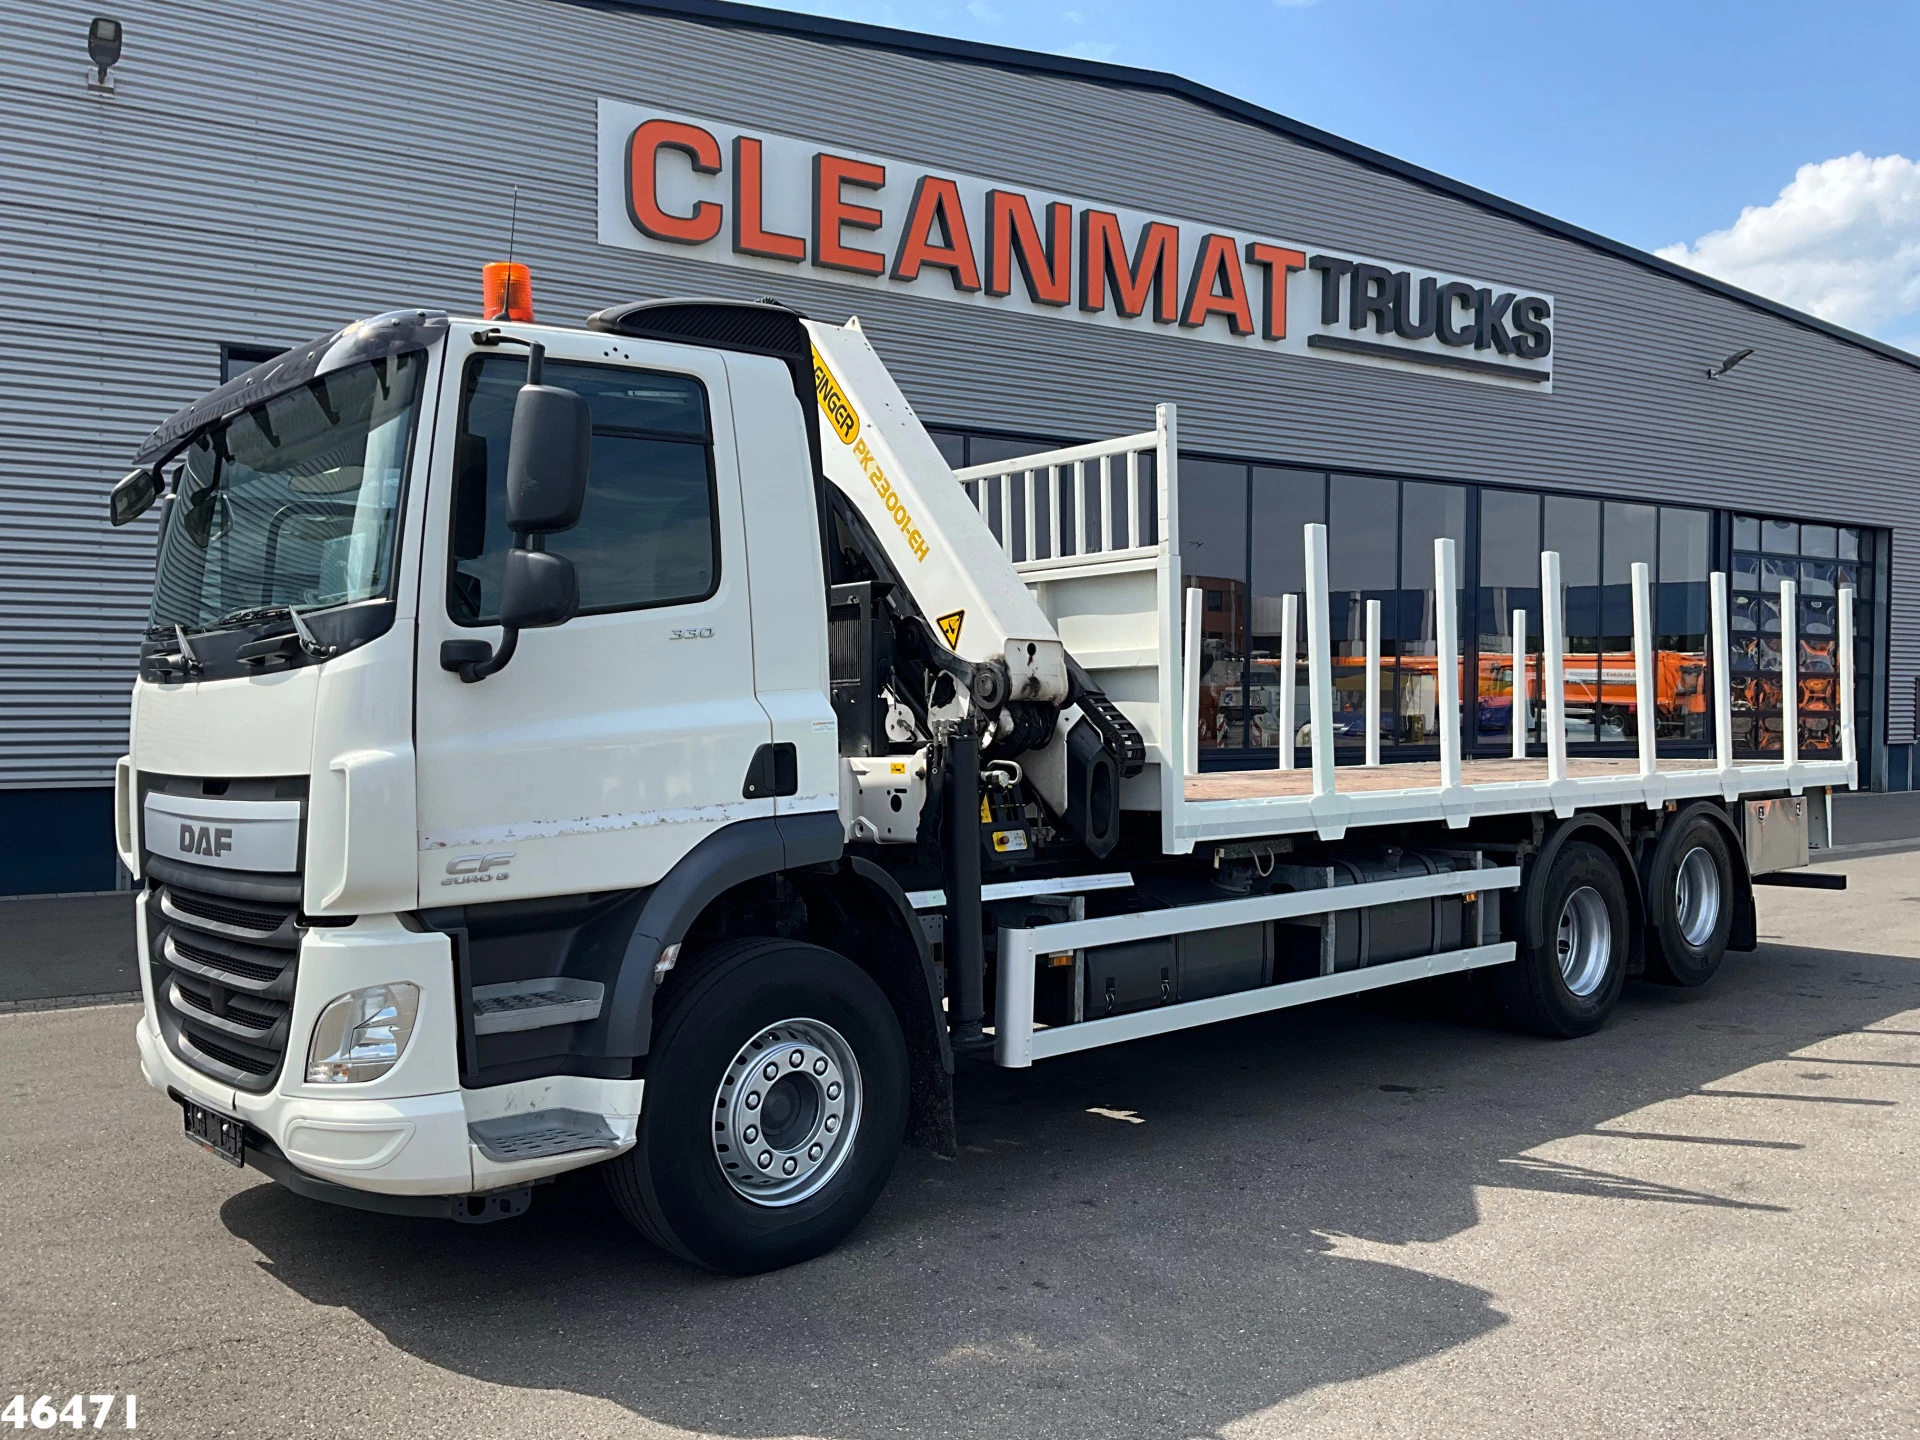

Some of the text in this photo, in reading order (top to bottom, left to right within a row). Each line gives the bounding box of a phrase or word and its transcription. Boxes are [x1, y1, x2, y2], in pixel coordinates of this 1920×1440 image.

[624, 118, 1552, 360] CLEANMAT TRUCKS
[852, 436, 931, 563] PK 23001-EH
[669, 627, 715, 641] 330
[179, 823, 233, 858] DAF
[445, 851, 518, 875] CF
[440, 871, 509, 886] EURO 6
